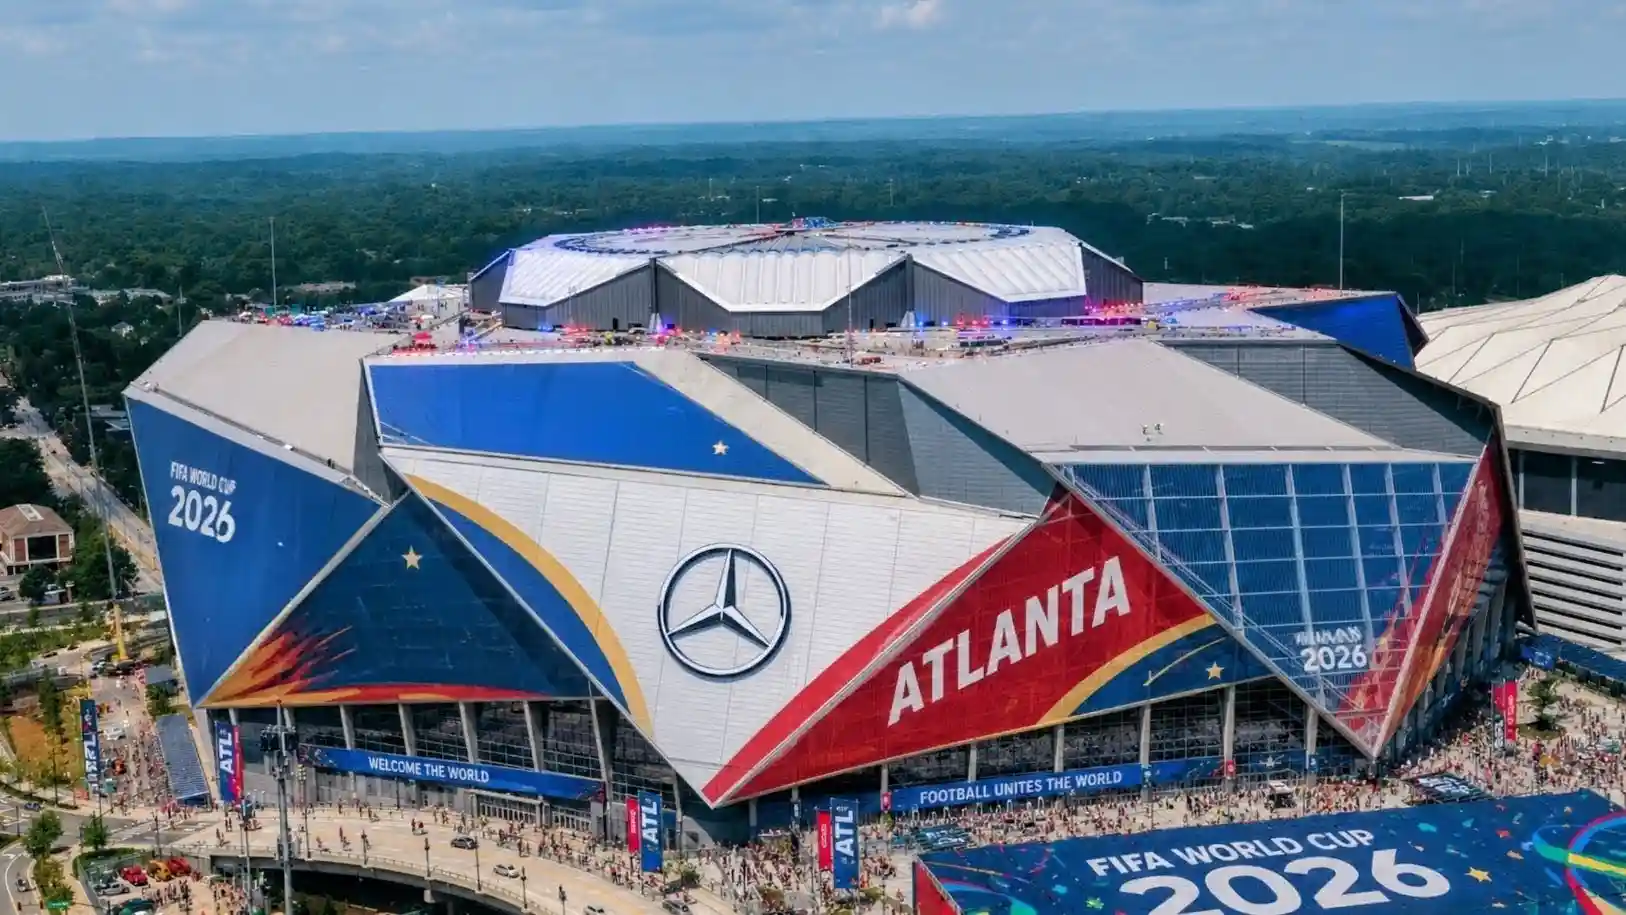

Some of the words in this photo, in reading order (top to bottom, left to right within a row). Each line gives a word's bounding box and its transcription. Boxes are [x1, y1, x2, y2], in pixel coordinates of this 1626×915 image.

[170, 461, 188, 481] FIFA
[189, 467, 218, 490] WORLD
[168, 485, 235, 543] 2026
[887, 556, 1131, 727] ATLANTA
[1301, 644, 1367, 673] 2026
[220, 732, 234, 774] ATL
[368, 757, 421, 776] WELCOME
[424, 764, 445, 778] THE
[447, 766, 489, 783] WORLD
[920, 787, 990, 804] FOOTBALL
[995, 779, 1042, 797] UNITES
[1048, 775, 1071, 790] THE
[1076, 770, 1123, 787] WORLD
[641, 801, 658, 844] ATL
[834, 810, 854, 857] ATL
[1086, 852, 1175, 877] FIFA
[1173, 837, 1303, 866] WORLD
[1307, 829, 1375, 849] CUP
[1119, 848, 1451, 915] 2026
